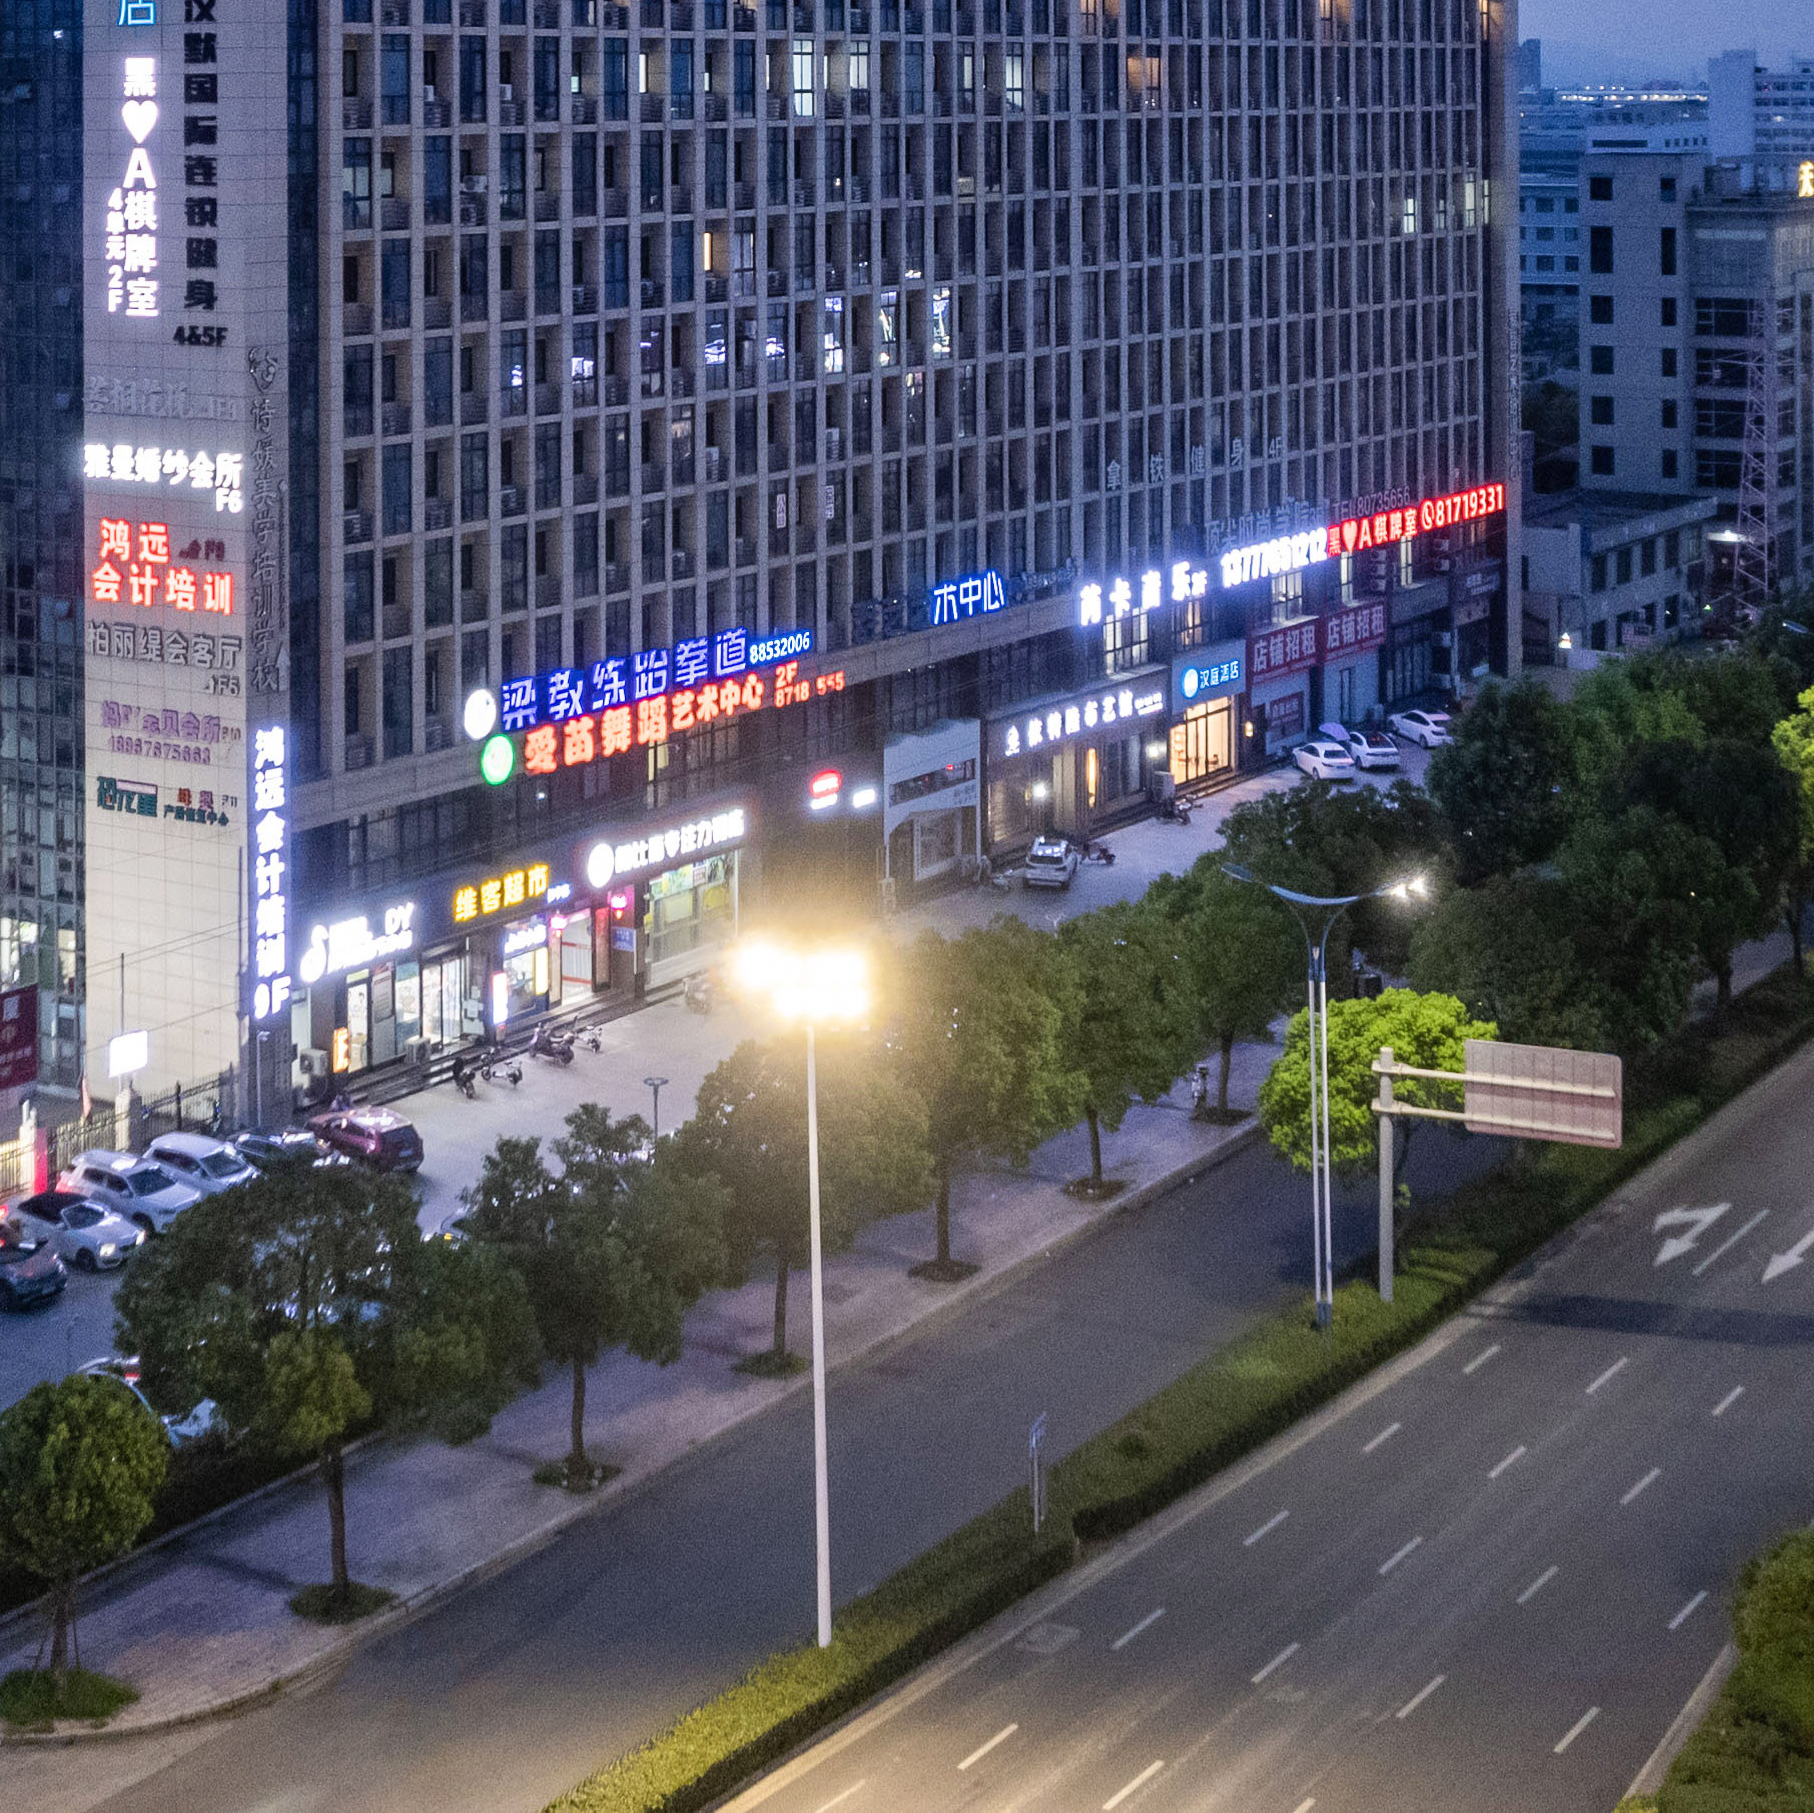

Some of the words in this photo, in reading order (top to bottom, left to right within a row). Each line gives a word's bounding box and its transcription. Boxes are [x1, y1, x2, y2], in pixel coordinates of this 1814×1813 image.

[215, 488, 242, 513] F6
[1434, 484, 1504, 526] 81719331
[99, 517, 170, 564] 鸿远
[91, 560, 234, 616] 会计培训
[933, 571, 1005, 625] 术中心
[1253, 624, 1317, 672] 店铺招租
[502, 627, 749, 731] 梁教练跆拳道
[749, 631, 810, 665] 88532006
[774, 661, 798, 688] 2F
[1199, 660, 1239, 689] 汉庭酒店
[454, 864, 549, 923] 维客超市
